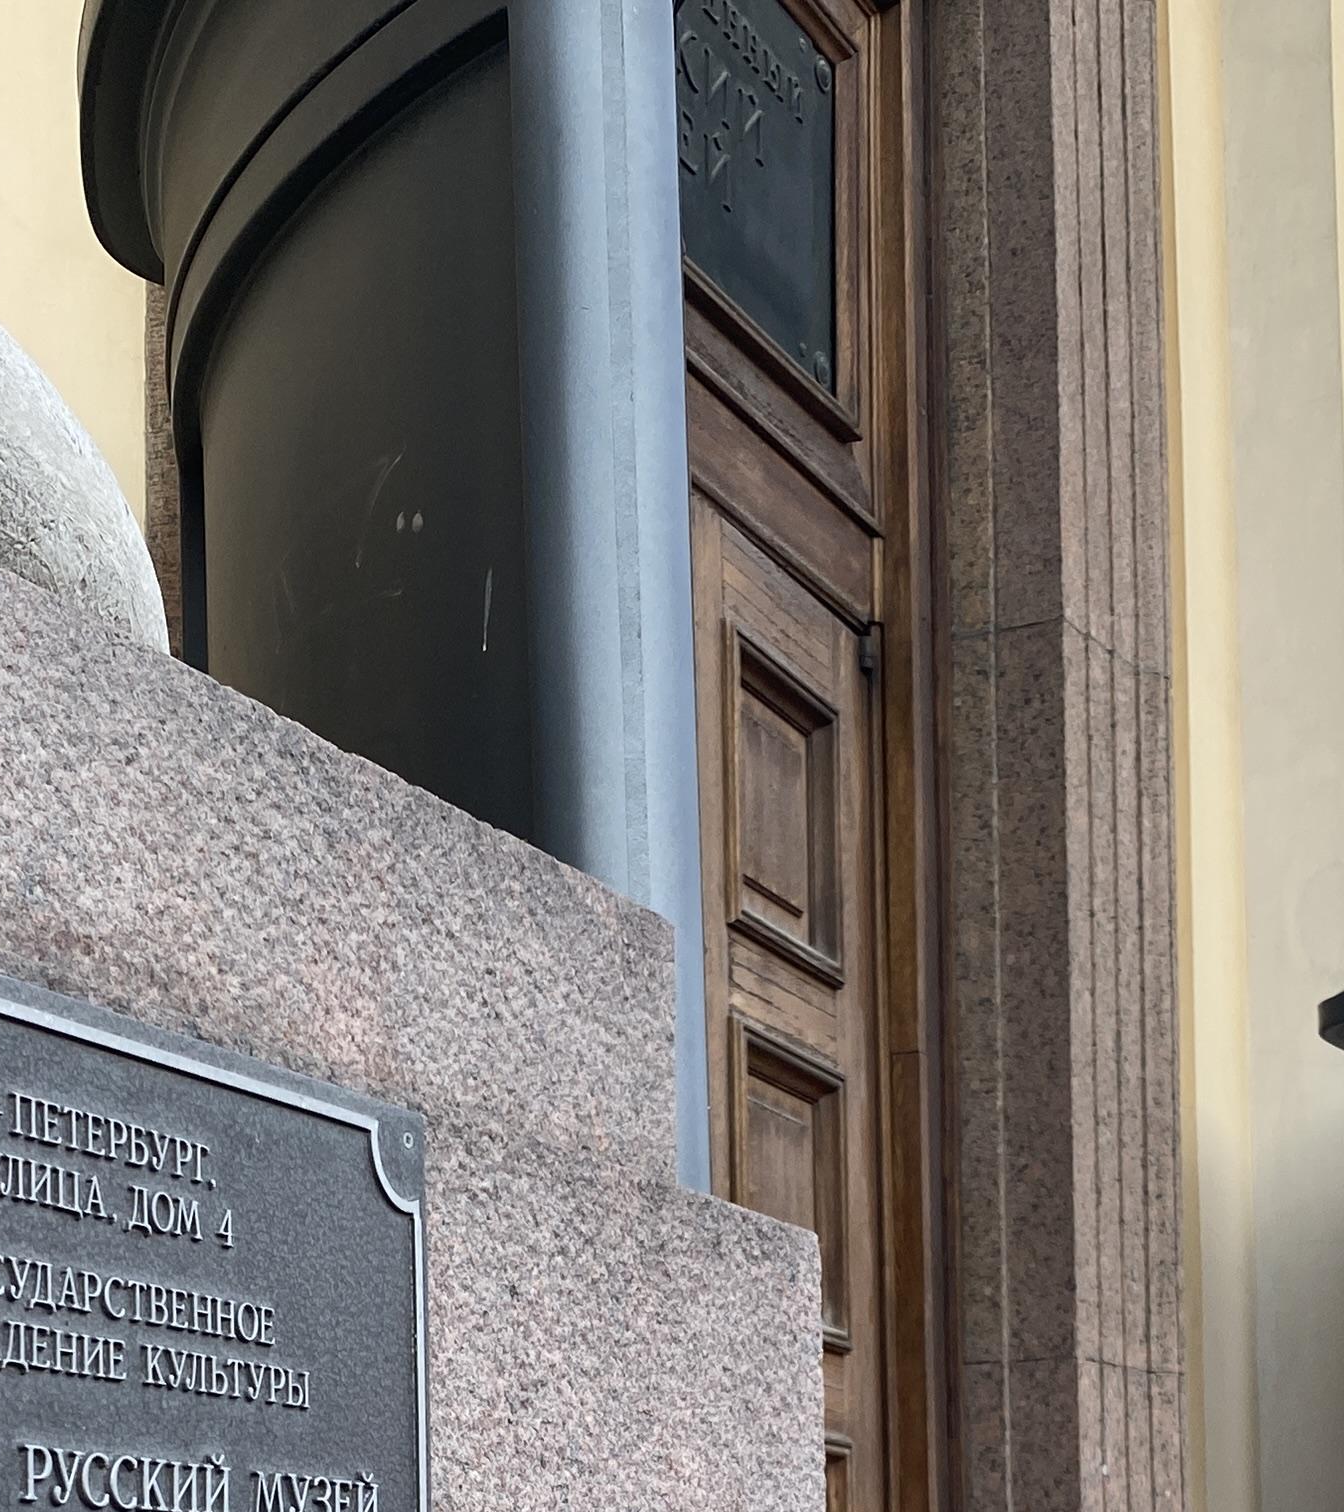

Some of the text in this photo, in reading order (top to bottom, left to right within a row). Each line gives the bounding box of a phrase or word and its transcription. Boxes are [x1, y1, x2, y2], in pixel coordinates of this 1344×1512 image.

[126, 1185, 204, 1240] ДОМ
[217, 1209, 234, 1249] 4
[142, 1344, 311, 1409] КУЛЬТУРЫ
